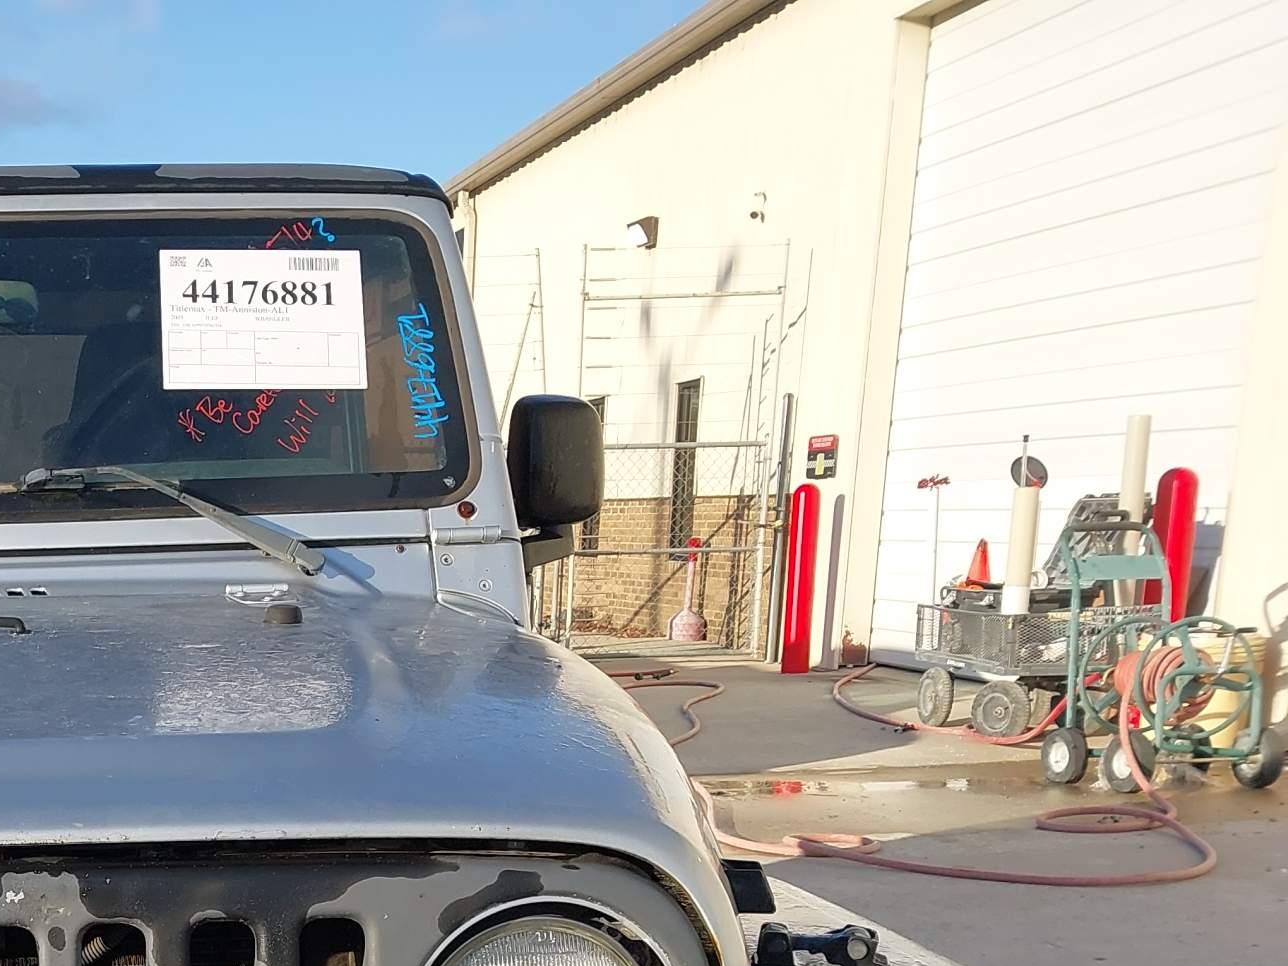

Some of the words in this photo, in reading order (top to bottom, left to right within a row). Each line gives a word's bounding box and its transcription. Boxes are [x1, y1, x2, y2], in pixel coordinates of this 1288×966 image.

[181, 279, 336, 306] 44176881
[195, 395, 233, 424] Be
[277, 398, 320, 454] Will
